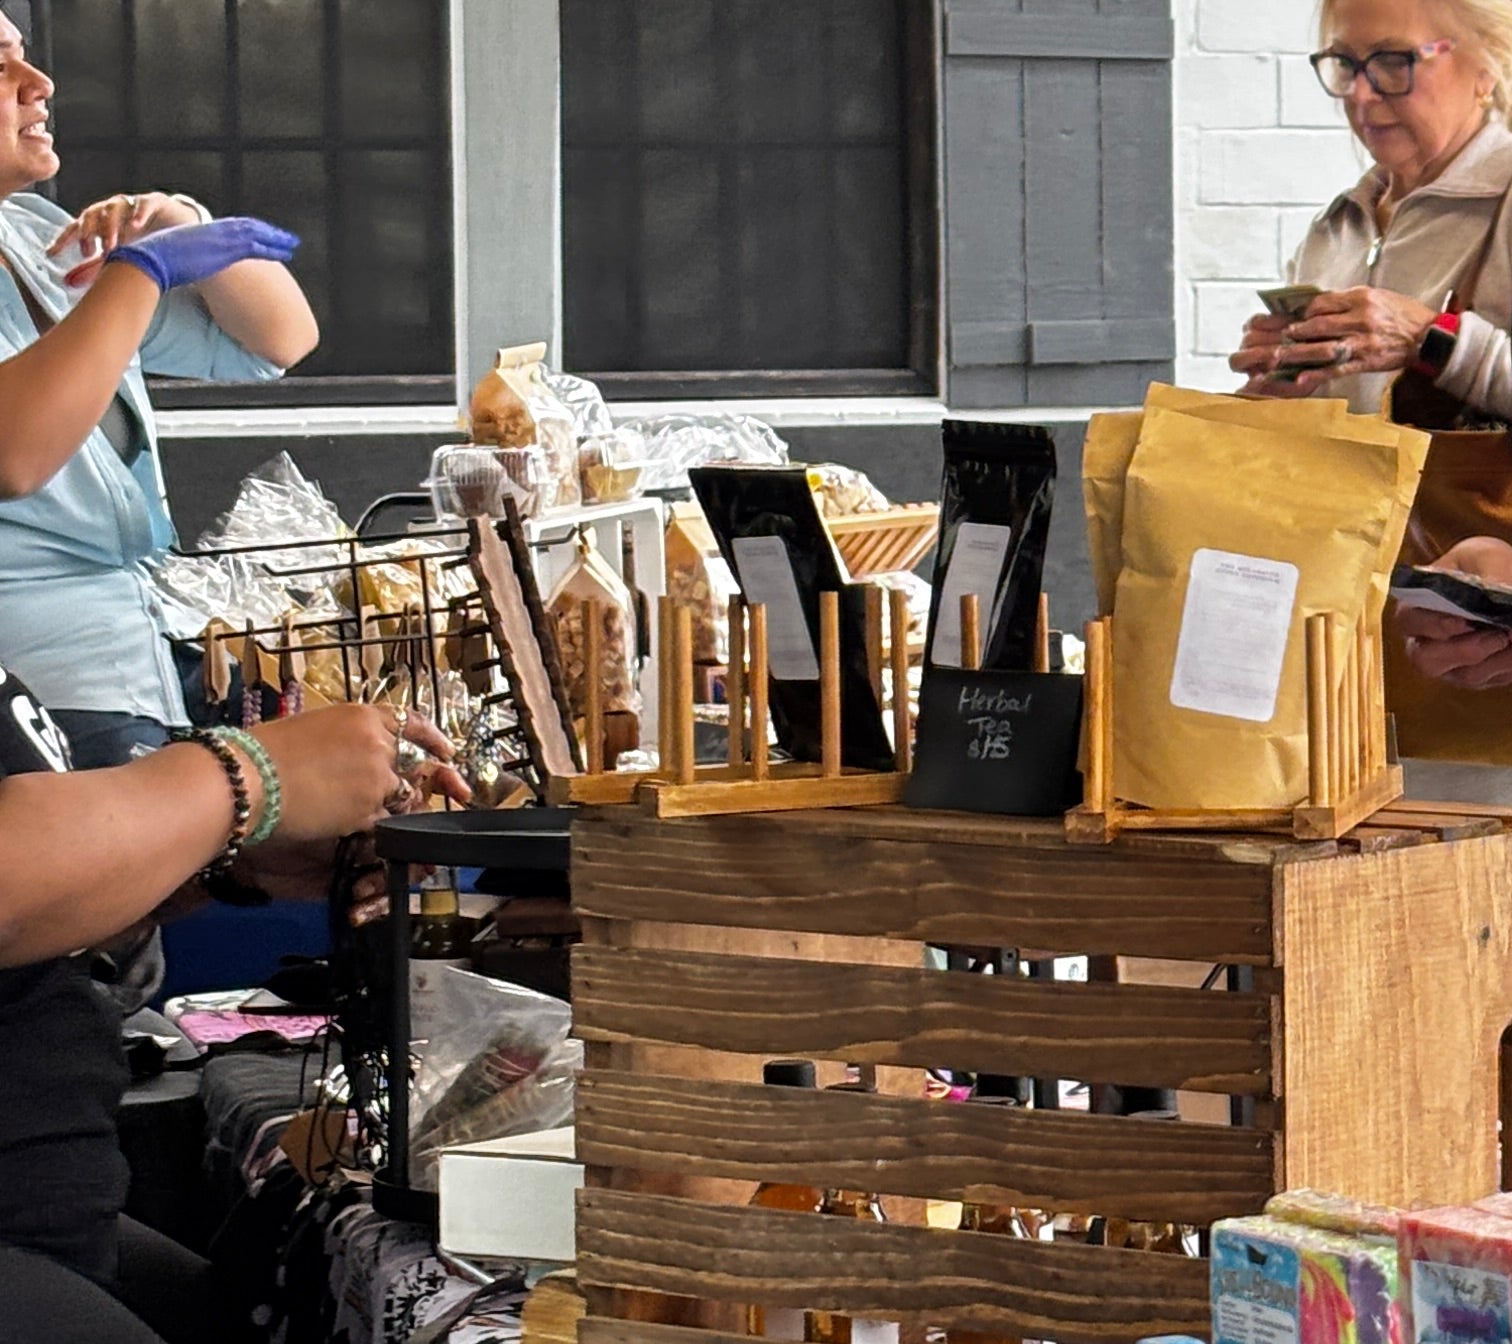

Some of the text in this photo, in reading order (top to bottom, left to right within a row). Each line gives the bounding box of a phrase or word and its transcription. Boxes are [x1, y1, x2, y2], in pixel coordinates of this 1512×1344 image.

[959, 686, 1032, 712] Herbal
[968, 717, 1012, 736] Tea
[968, 735, 1011, 759] $15
